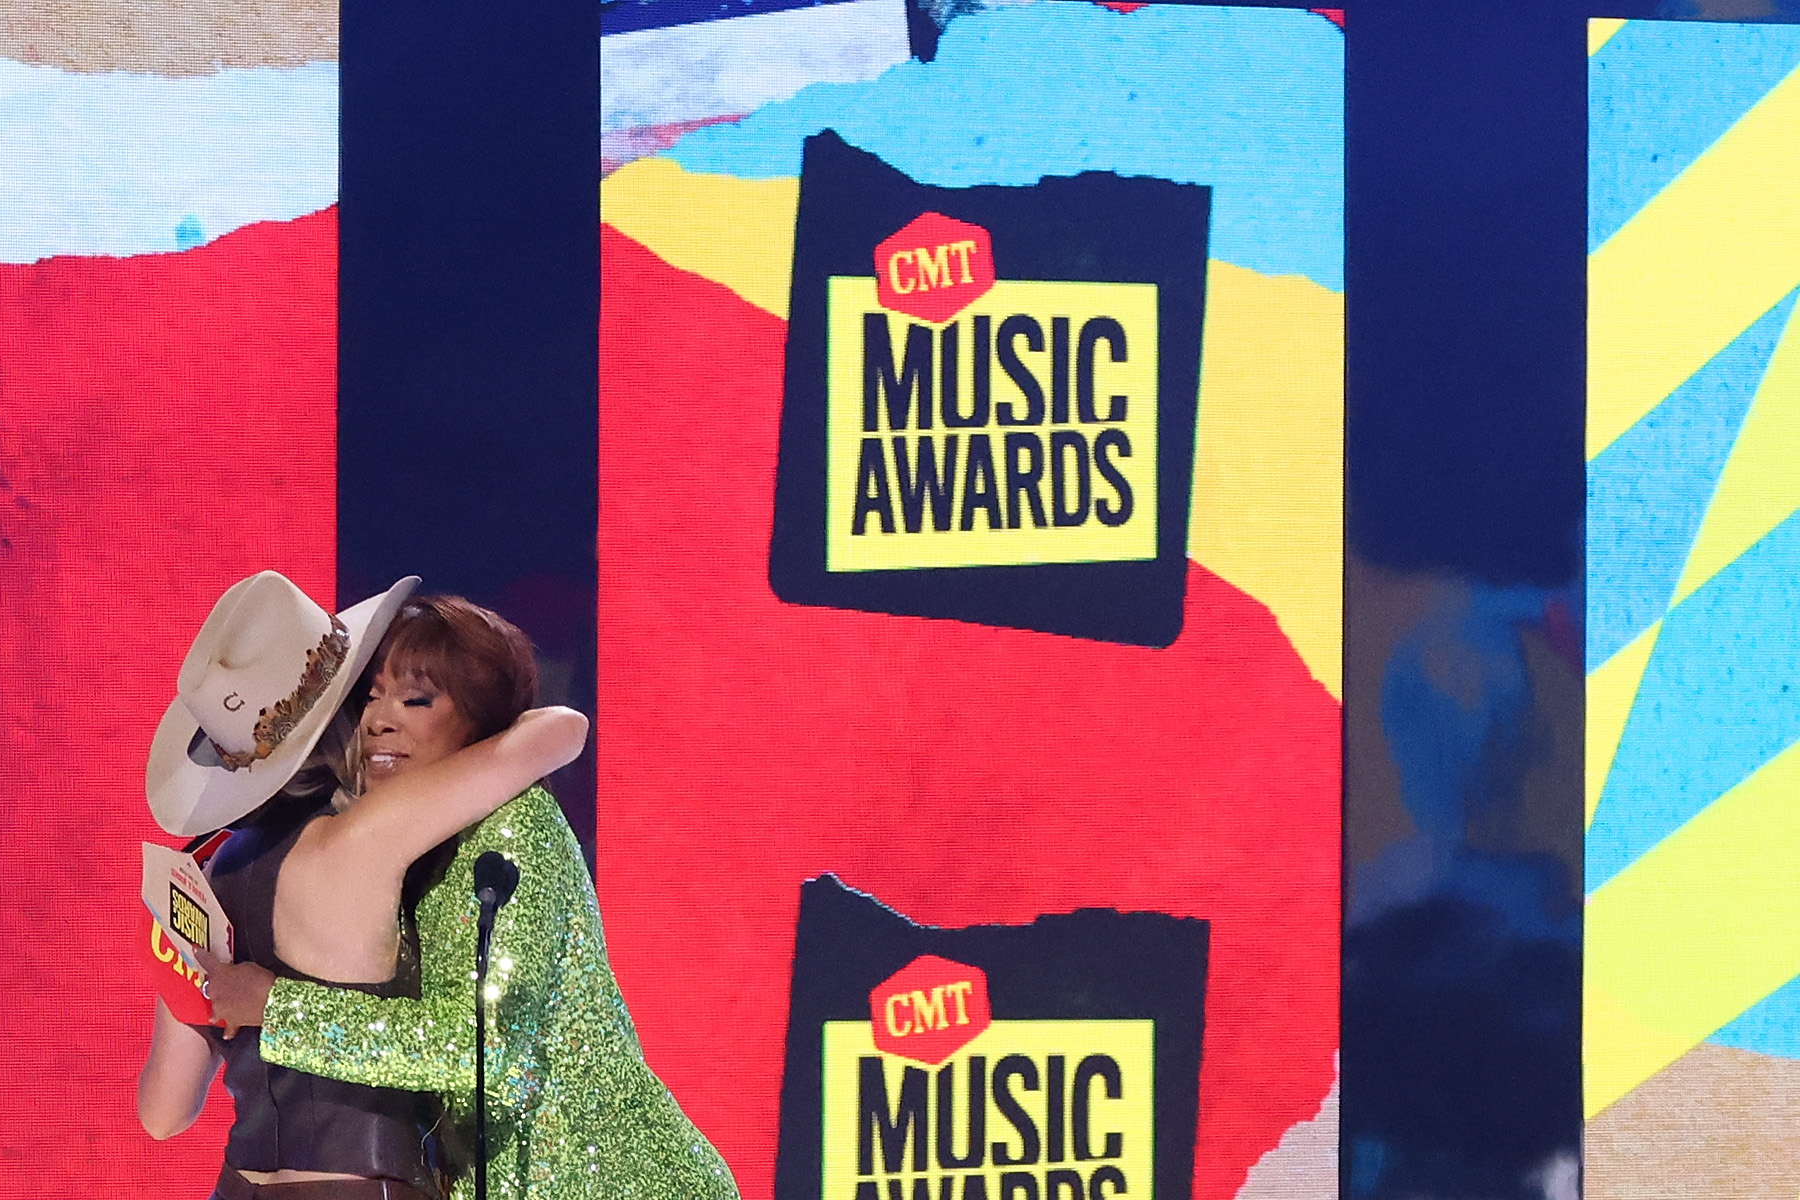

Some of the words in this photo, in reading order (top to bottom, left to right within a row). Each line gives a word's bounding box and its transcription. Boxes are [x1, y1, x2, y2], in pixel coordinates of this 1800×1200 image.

[889, 241, 976, 294] CMT
[863, 313, 1127, 432] MUSIC
[852, 428, 1133, 535] AWARDS
[886, 982, 972, 1036] CMT
[858, 1054, 1122, 1175] MUSIC
